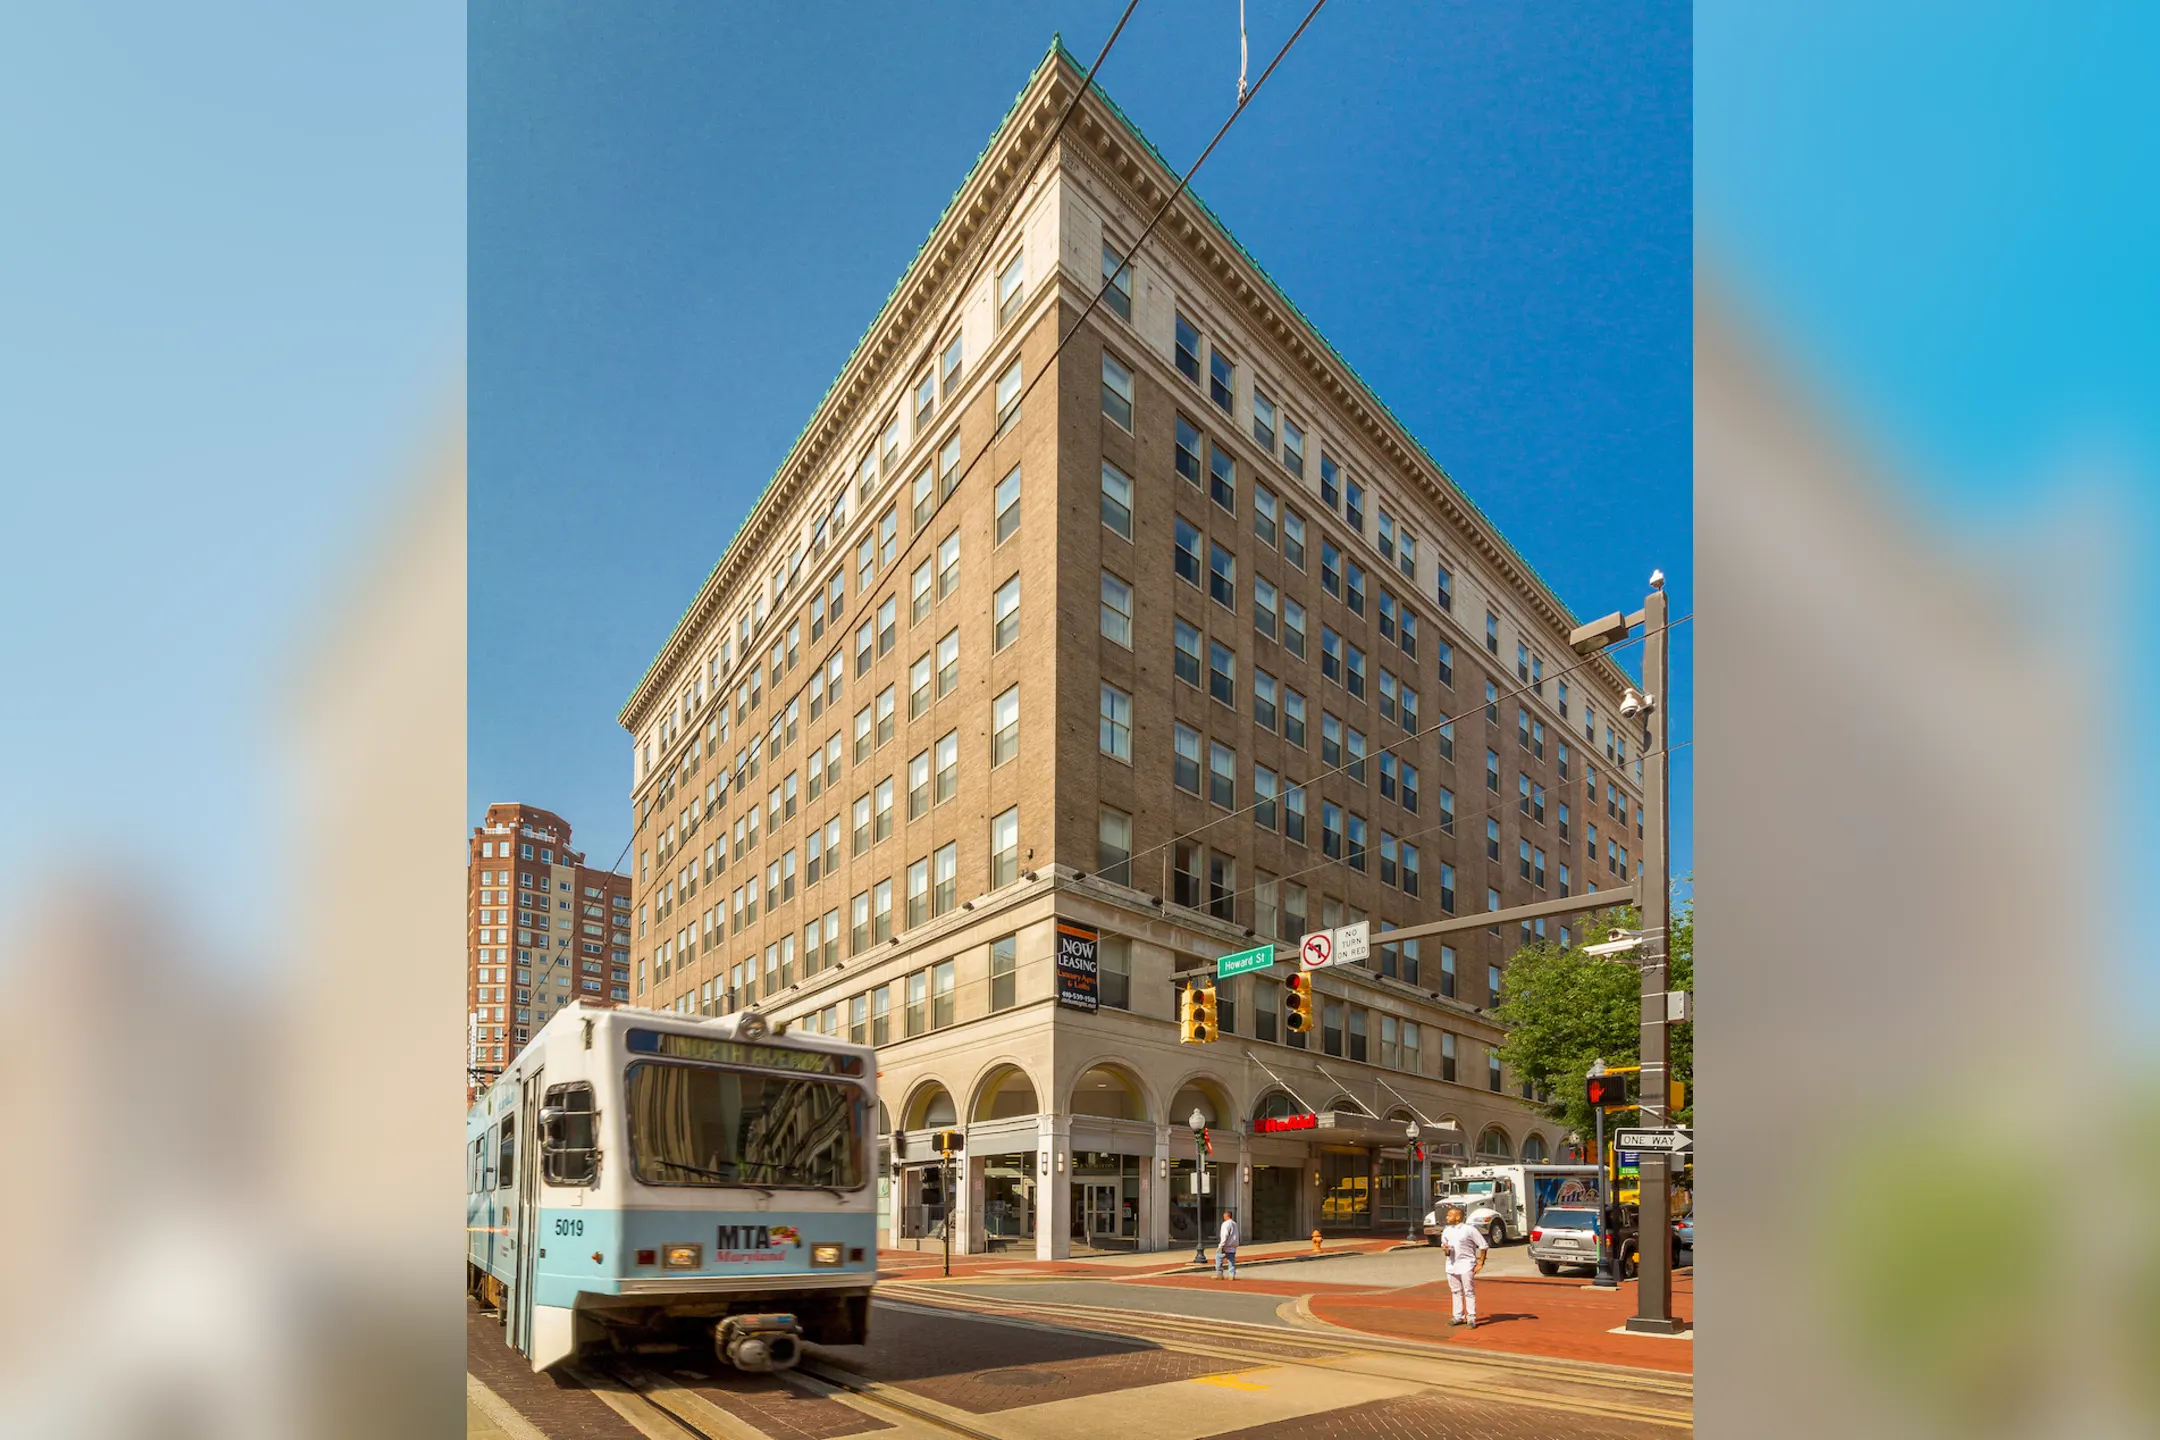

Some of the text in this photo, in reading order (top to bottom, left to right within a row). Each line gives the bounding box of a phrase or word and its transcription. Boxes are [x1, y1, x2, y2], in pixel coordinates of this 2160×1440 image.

[1345, 929, 1357, 938] NO
[1062, 938, 1093, 958] NOW
[1342, 938, 1362, 948] TURN
[1225, 952, 1265, 971] Howard St
[1337, 946, 1366, 960] ON RED
[1058, 954, 1096, 973] LEASING
[1623, 1136, 1676, 1145] ONE WAY
[555, 1218, 584, 1237] 5019
[717, 1224, 770, 1250] MTA
[714, 1250, 787, 1266] Maryland
